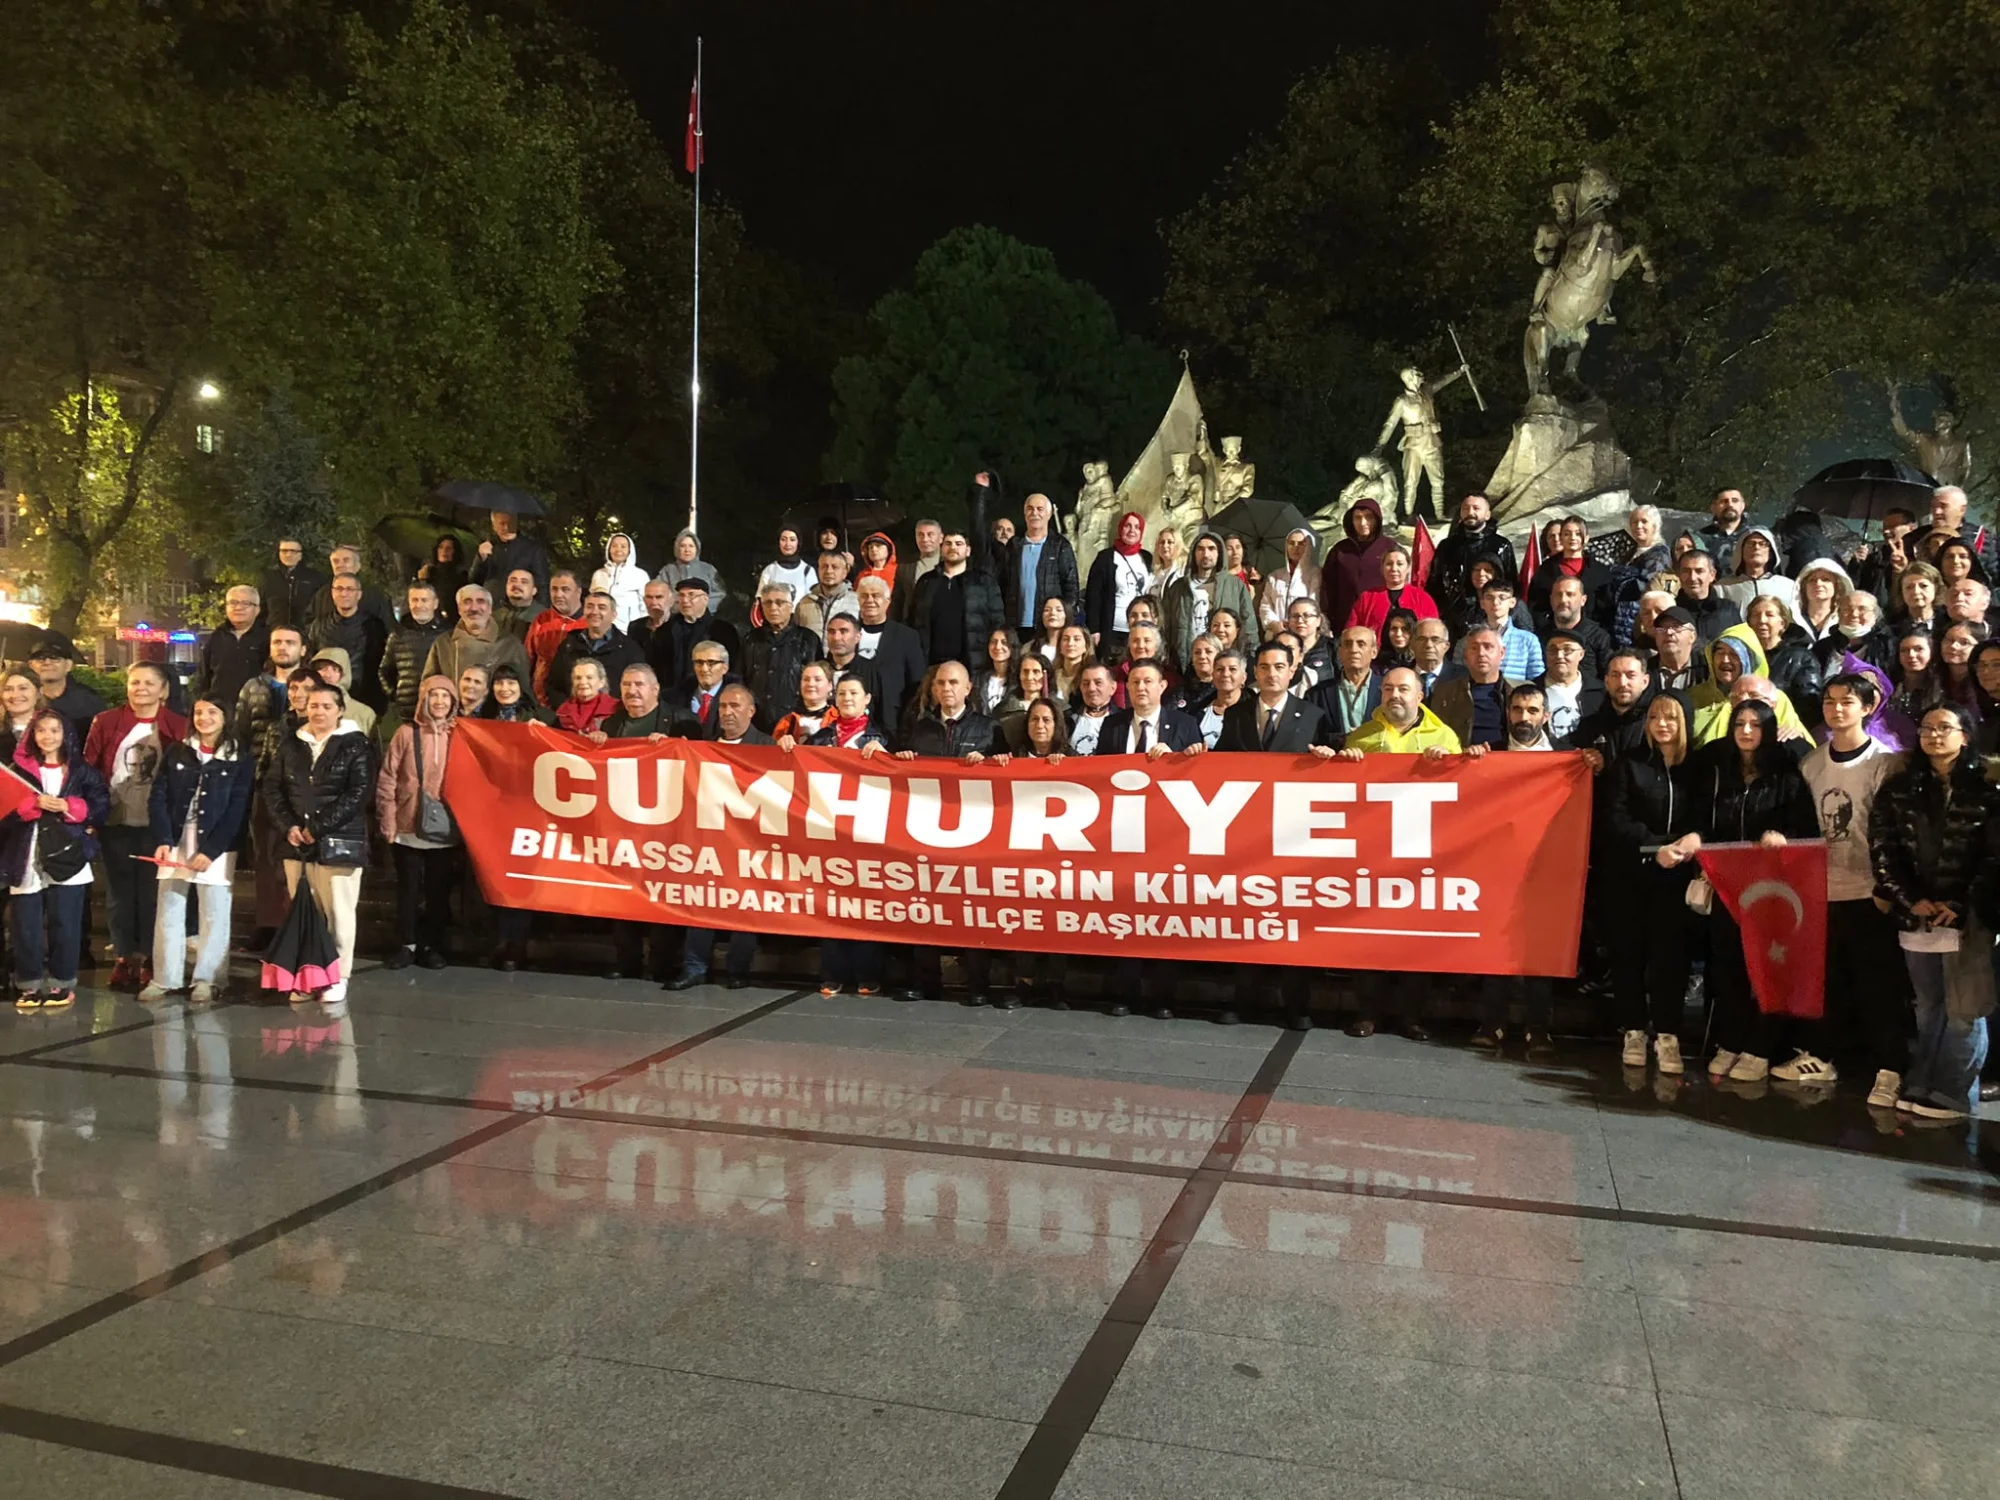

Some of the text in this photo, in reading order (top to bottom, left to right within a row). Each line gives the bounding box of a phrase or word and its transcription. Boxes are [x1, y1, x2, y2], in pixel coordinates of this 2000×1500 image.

[532, 751, 1459, 859] CUMHURİYET
[509, 823, 1482, 912] BİLHASSA KİMSESİZLERİN KİMSESİDİR
[644, 880, 1300, 942] YENİPARTİ İNEGÖL İLÇE BAŞKANLIĞI
